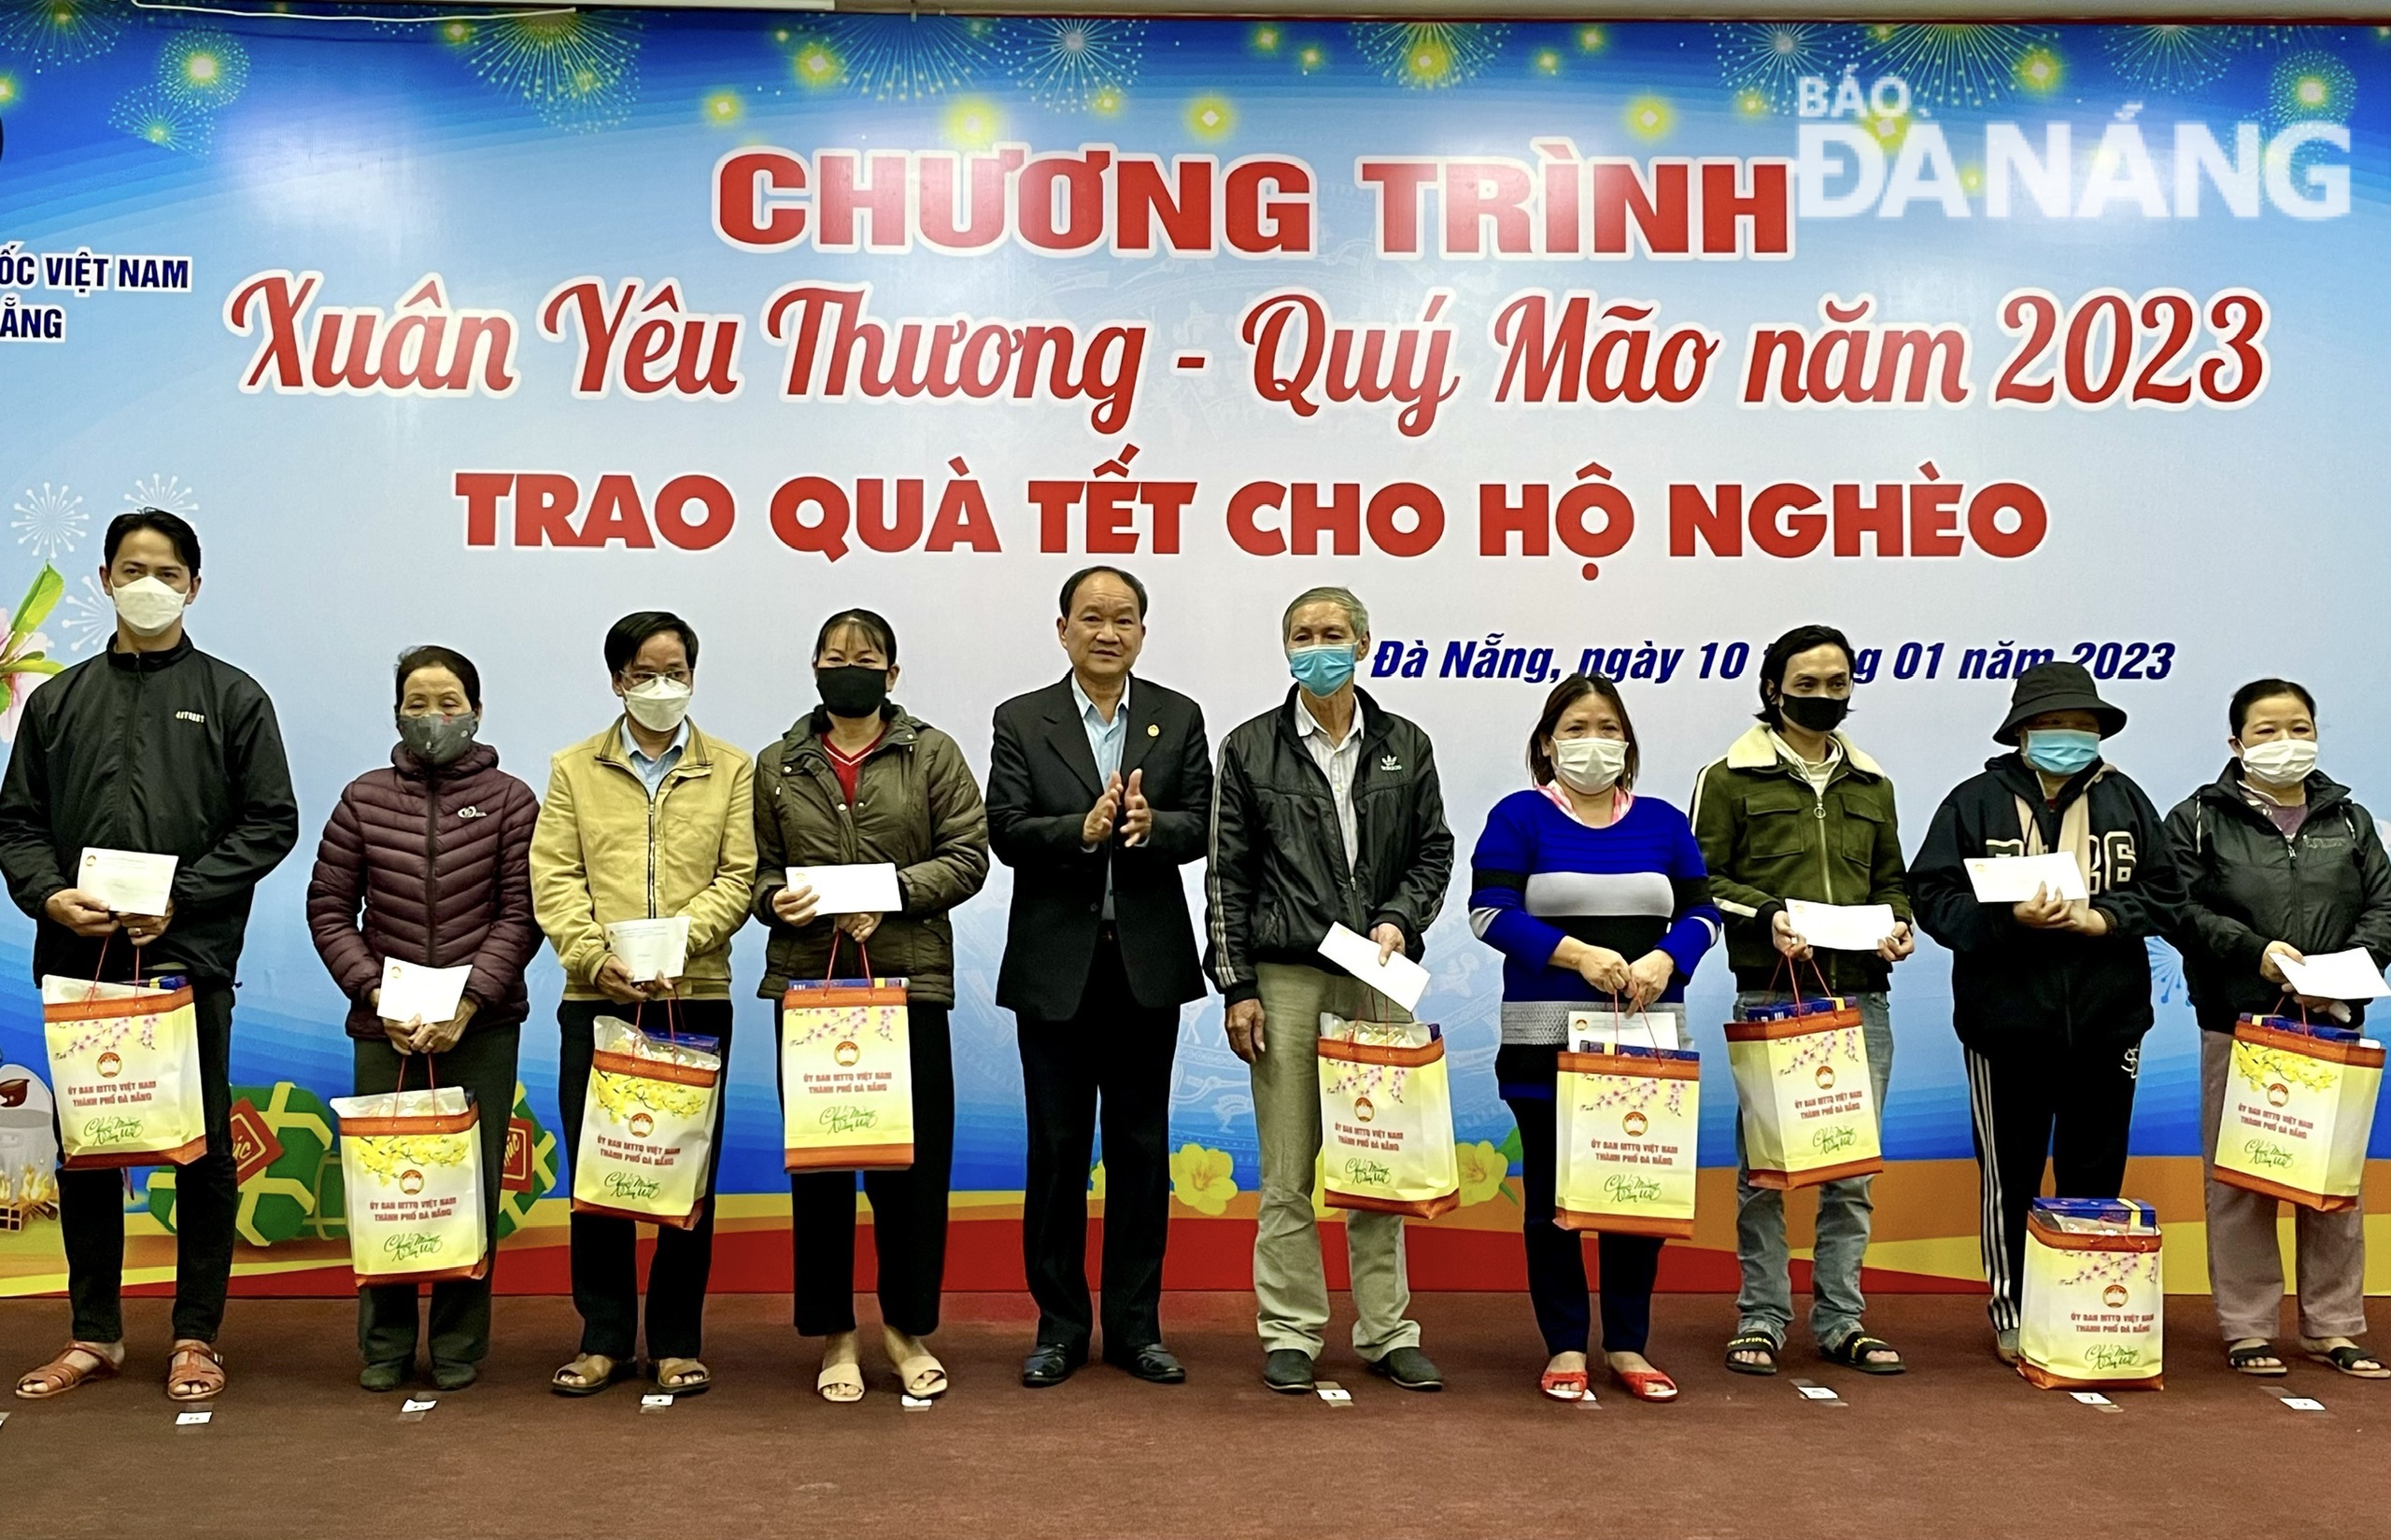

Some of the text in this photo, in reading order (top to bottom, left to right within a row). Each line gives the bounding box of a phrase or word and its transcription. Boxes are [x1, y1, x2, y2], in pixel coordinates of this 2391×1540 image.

[719, 145, 1789, 254] CHƯƠNG TRÌNH
[46, 252, 109, 292] VIỆT
[119, 259, 188, 289] NAM
[232, 276, 2264, 437] Xuân Yêu Thương - Quý Mão năm 2023
[455, 444, 2048, 581] TRAO QUÀ TẾT CHO HỘ NGHÈO
[1370, 640, 1429, 678] Đà
[1439, 633, 1561, 684] Nẵng,
[1577, 641, 1685, 684] ngày
[1699, 642, 1750, 679] 10
[1892, 642, 1945, 680] 01
[856, 1071, 872, 1081] VIỆT
[119, 1081, 135, 1092] VIỆT
[837, 1082, 853, 1092] PHỐ
[100, 1094, 116, 1105] PHỐ
[646, 1145, 663, 1156] VIỆT
[1643, 1144, 1660, 1153] VIỆT
[625, 1153, 642, 1163] PHỐ
[1622, 1153, 1638, 1163] PHỐ
[421, 1199, 437, 1208] VIỆT
[401, 1211, 417, 1221] PHỐ
[2123, 1314, 2140, 1323] VIỆT
[2103, 1323, 2118, 1332] PHỐ
